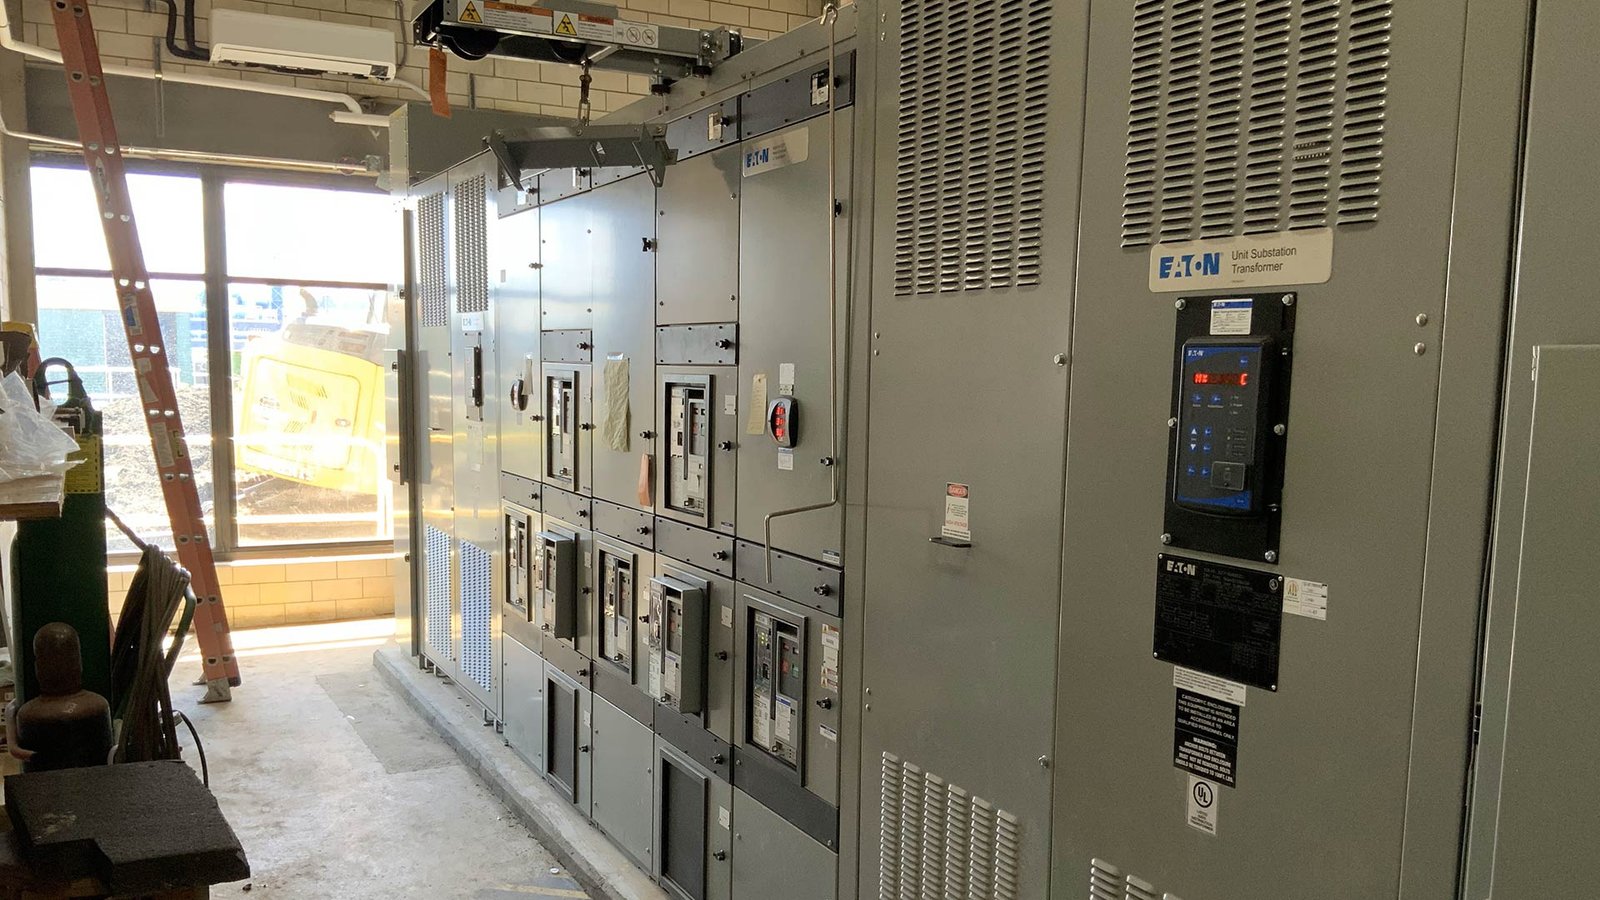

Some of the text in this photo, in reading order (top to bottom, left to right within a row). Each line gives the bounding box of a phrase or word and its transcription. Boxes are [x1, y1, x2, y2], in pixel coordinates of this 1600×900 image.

[747, 148, 769, 167] EATON
[1160, 247, 1297, 278] EATON Unit Substation
[1232, 262, 1283, 274] Transformer
[1167, 560, 1196, 576] EATON
[1198, 786, 1208, 803] UL
